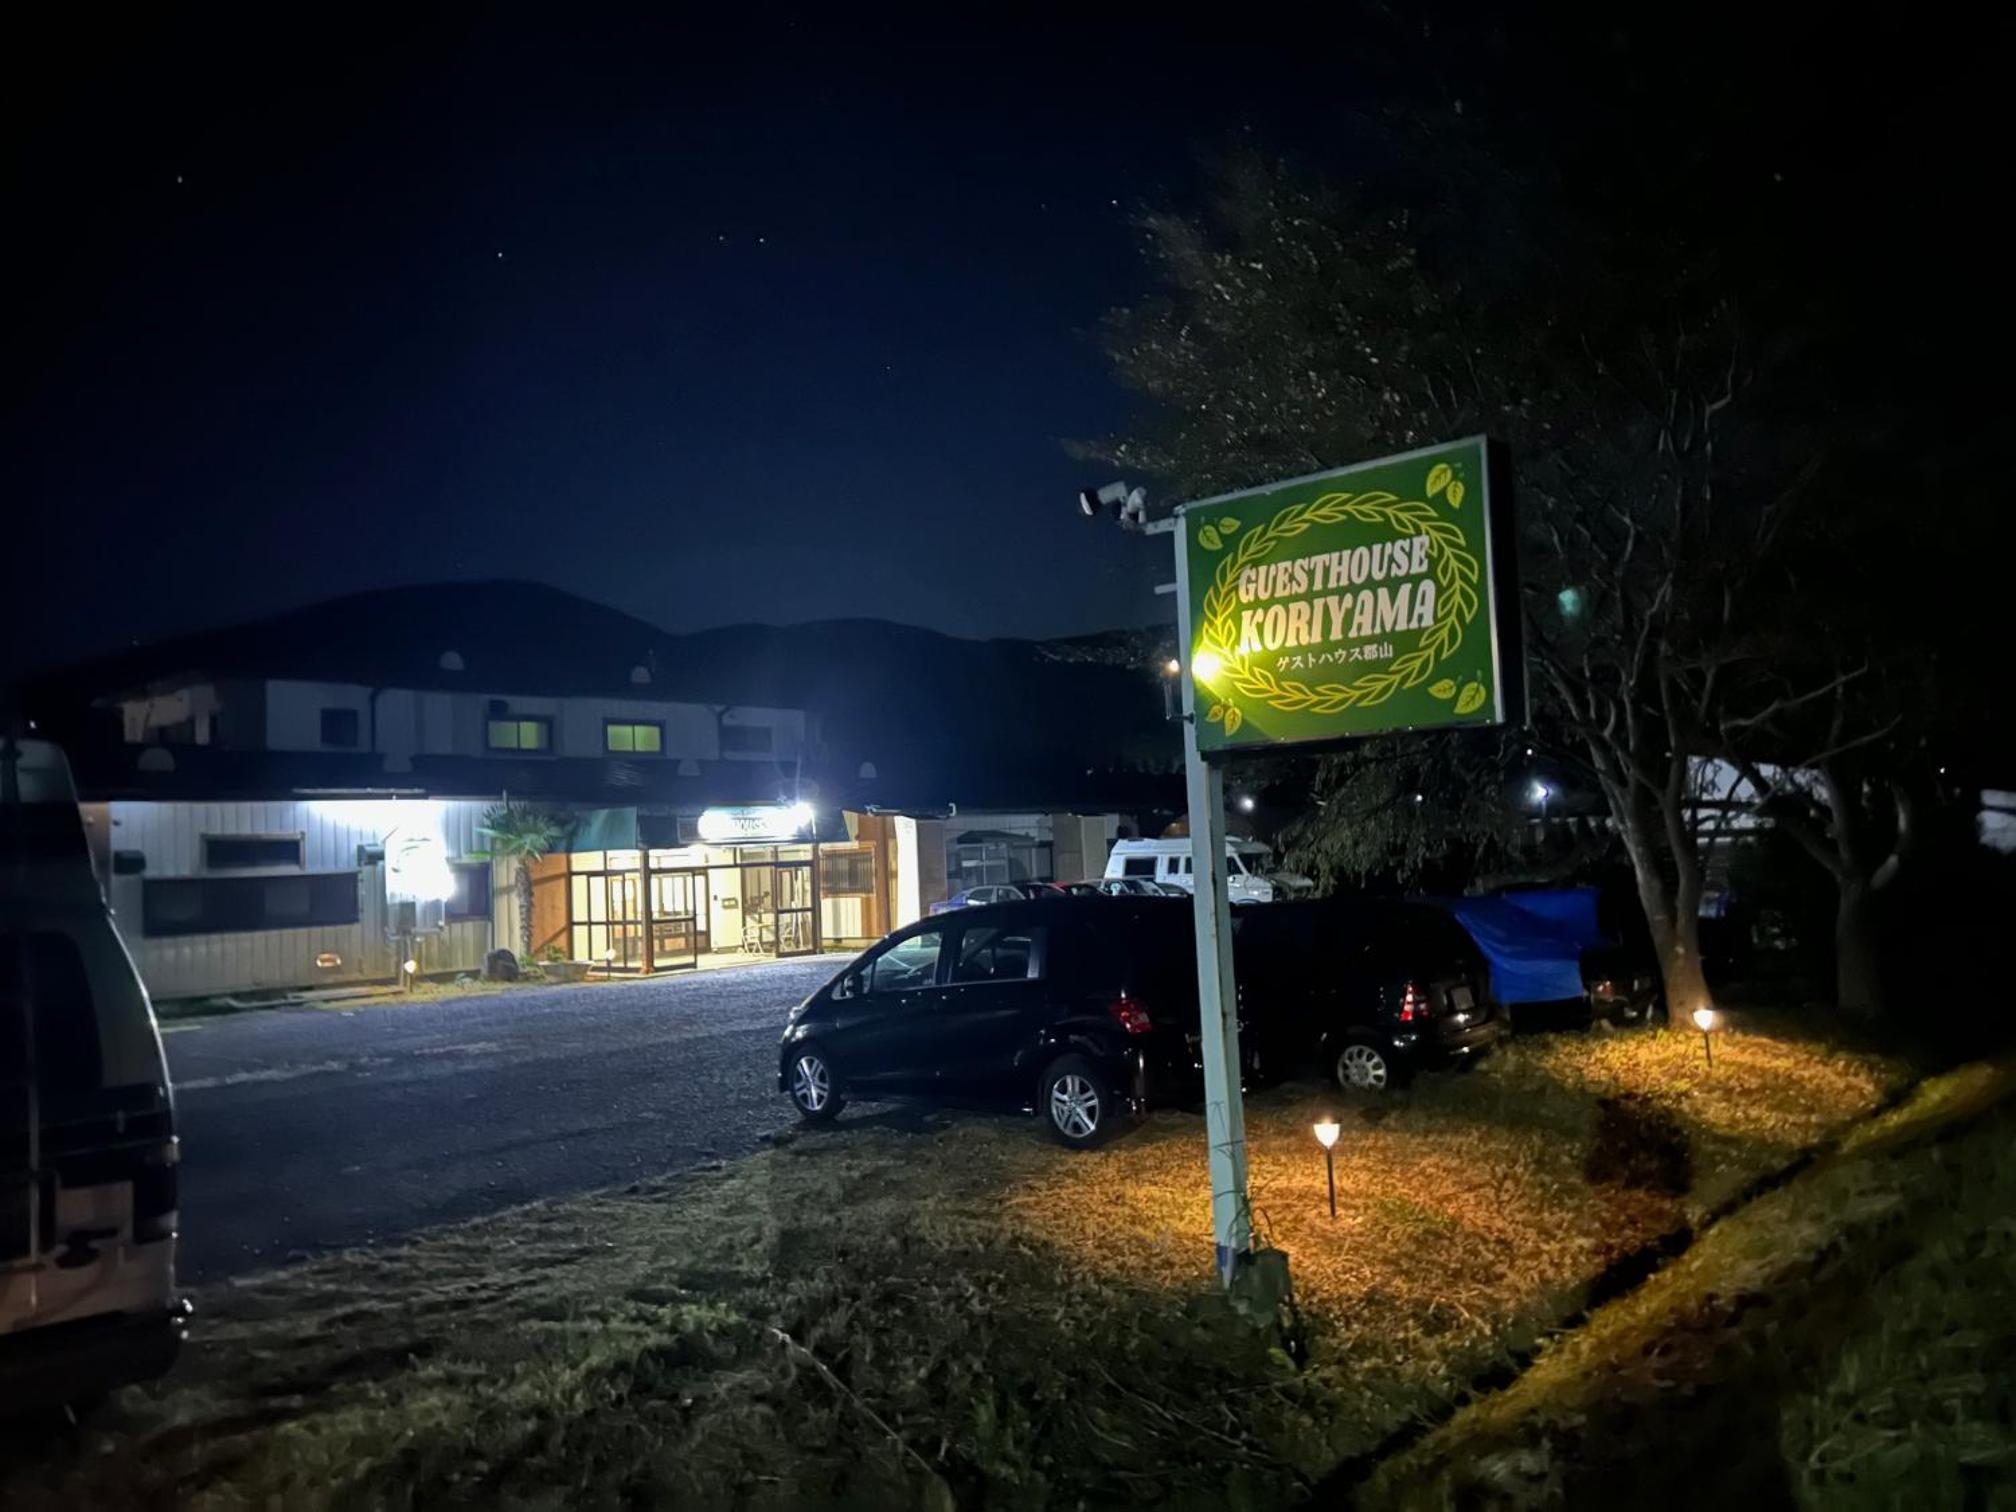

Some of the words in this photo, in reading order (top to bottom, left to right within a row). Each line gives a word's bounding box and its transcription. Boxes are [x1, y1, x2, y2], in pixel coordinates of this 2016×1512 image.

[1239, 535, 1430, 603] GUESTHOUSE
[1237, 579, 1436, 656] KORIYAMA
[1277, 642, 1393, 672] ゲストハウス郡山
